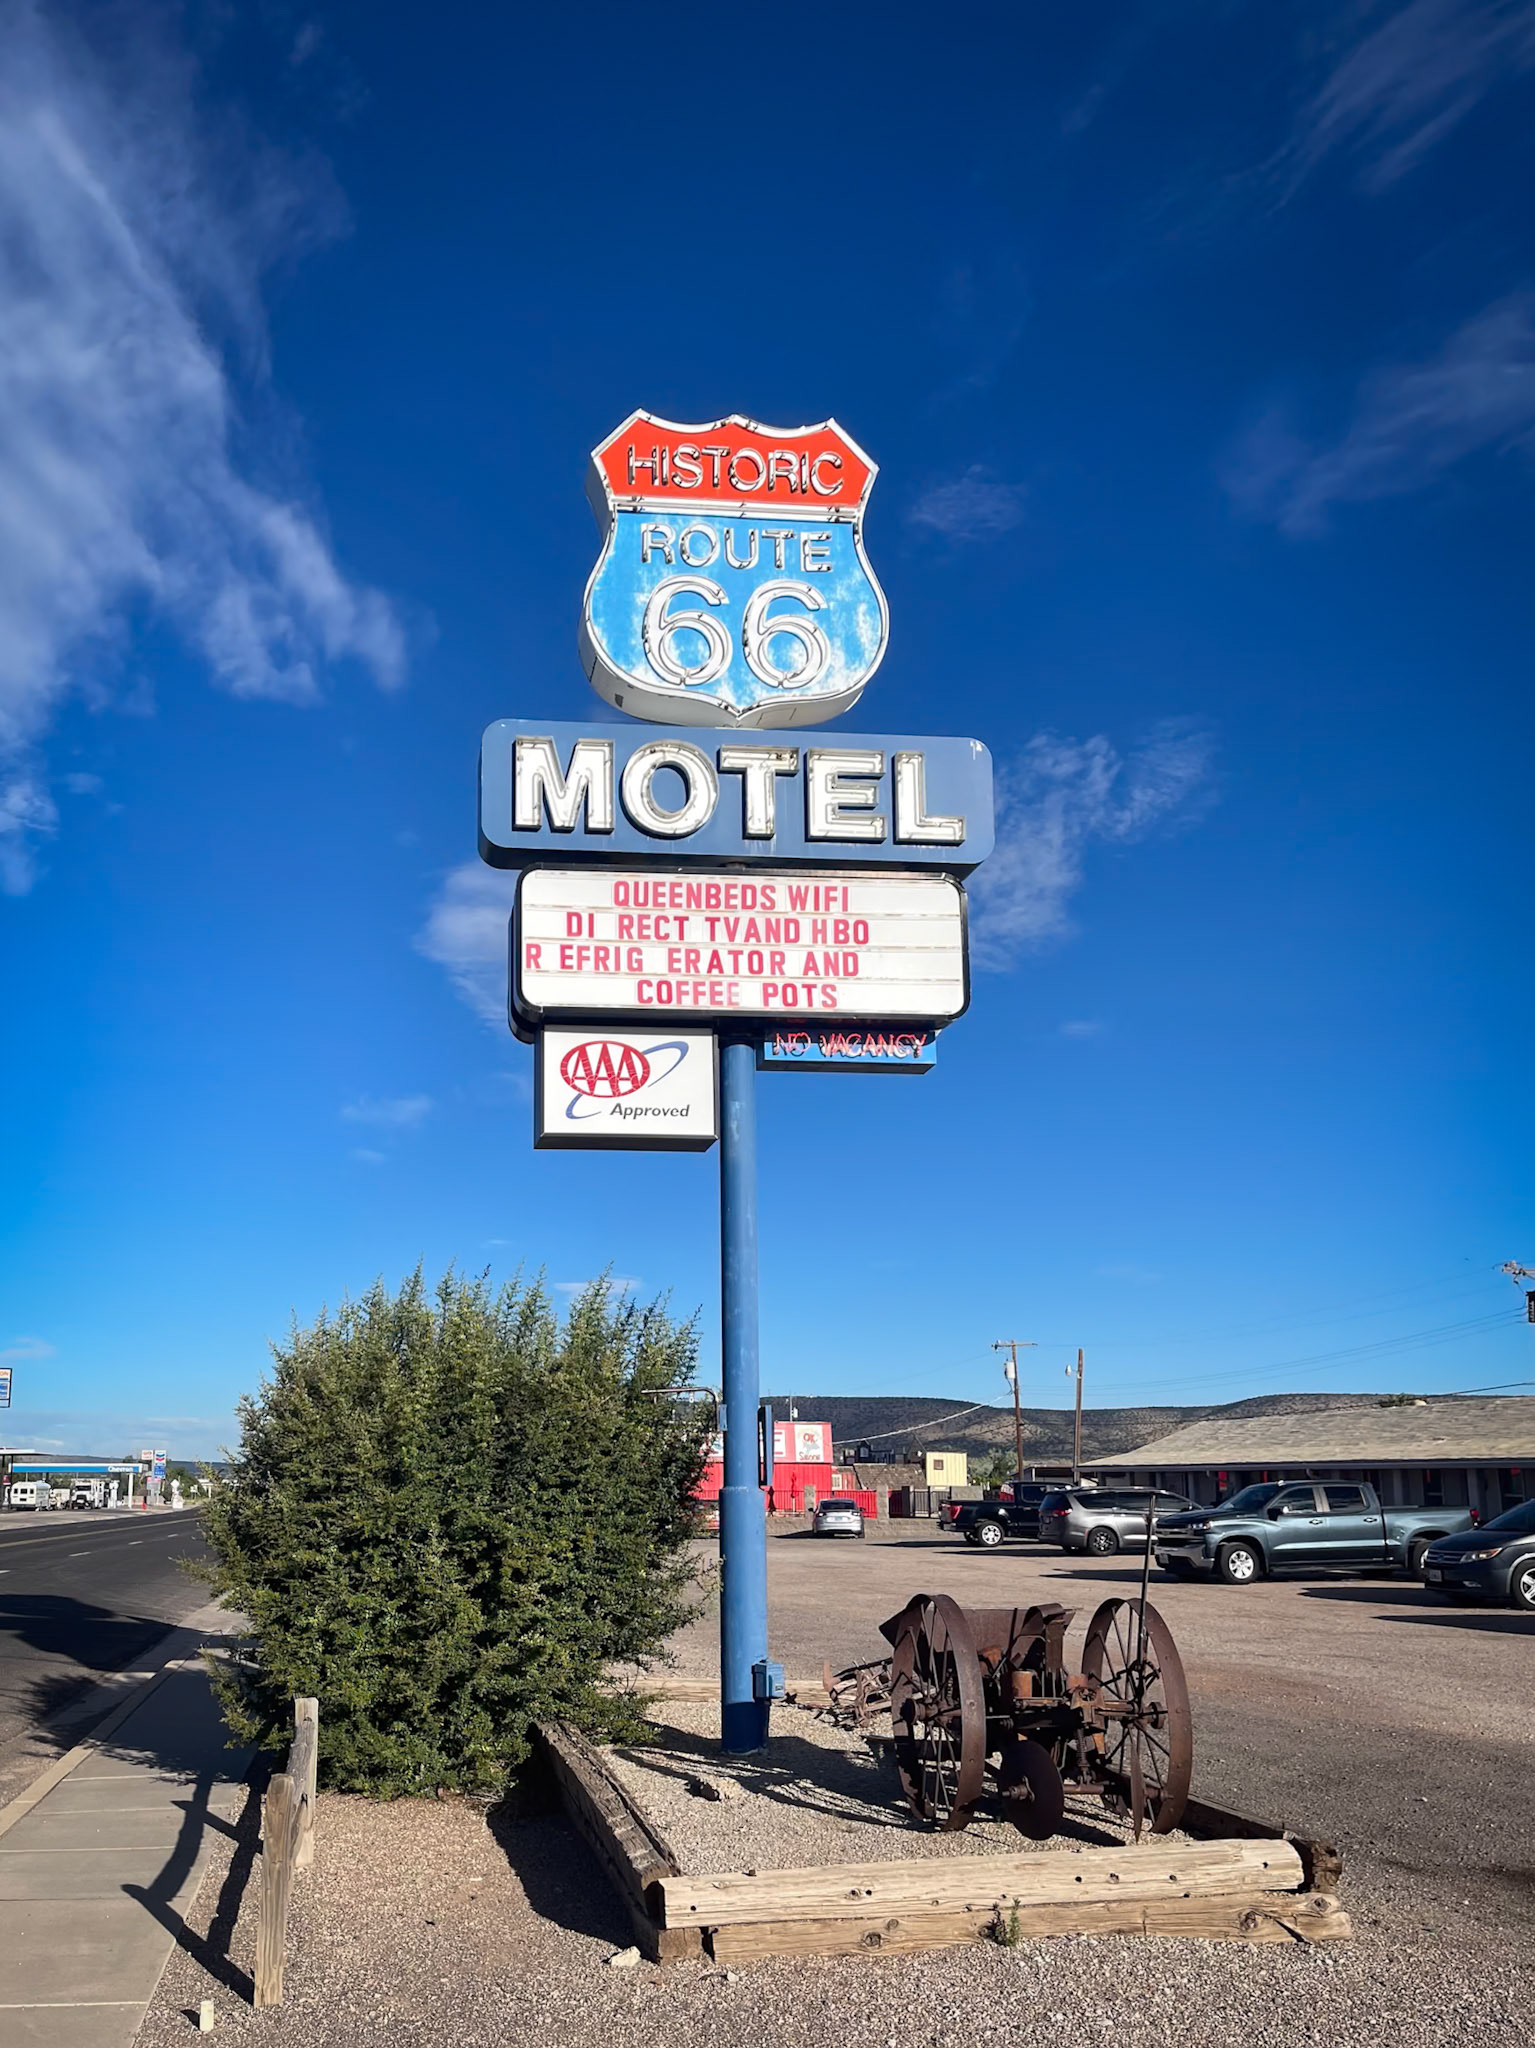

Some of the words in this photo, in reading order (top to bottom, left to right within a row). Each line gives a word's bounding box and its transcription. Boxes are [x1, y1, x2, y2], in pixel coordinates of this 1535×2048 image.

[627, 443, 844, 496] HISTORIC
[640, 522, 833, 572] ROUTE
[642, 574, 831, 689] 66
[511, 735, 966, 846] MOTEL
[787, 885, 849, 912] WIFI
[811, 918, 870, 945] HBO
[802, 951, 860, 977] AND
[636, 979, 740, 1007] COFFEE
[761, 982, 838, 1009] POTS
[772, 1032, 812, 1057] NO
[818, 1032, 928, 1059] VACANCY
[568, 1041, 643, 1097] AAA
[609, 1102, 691, 1120] Approved
